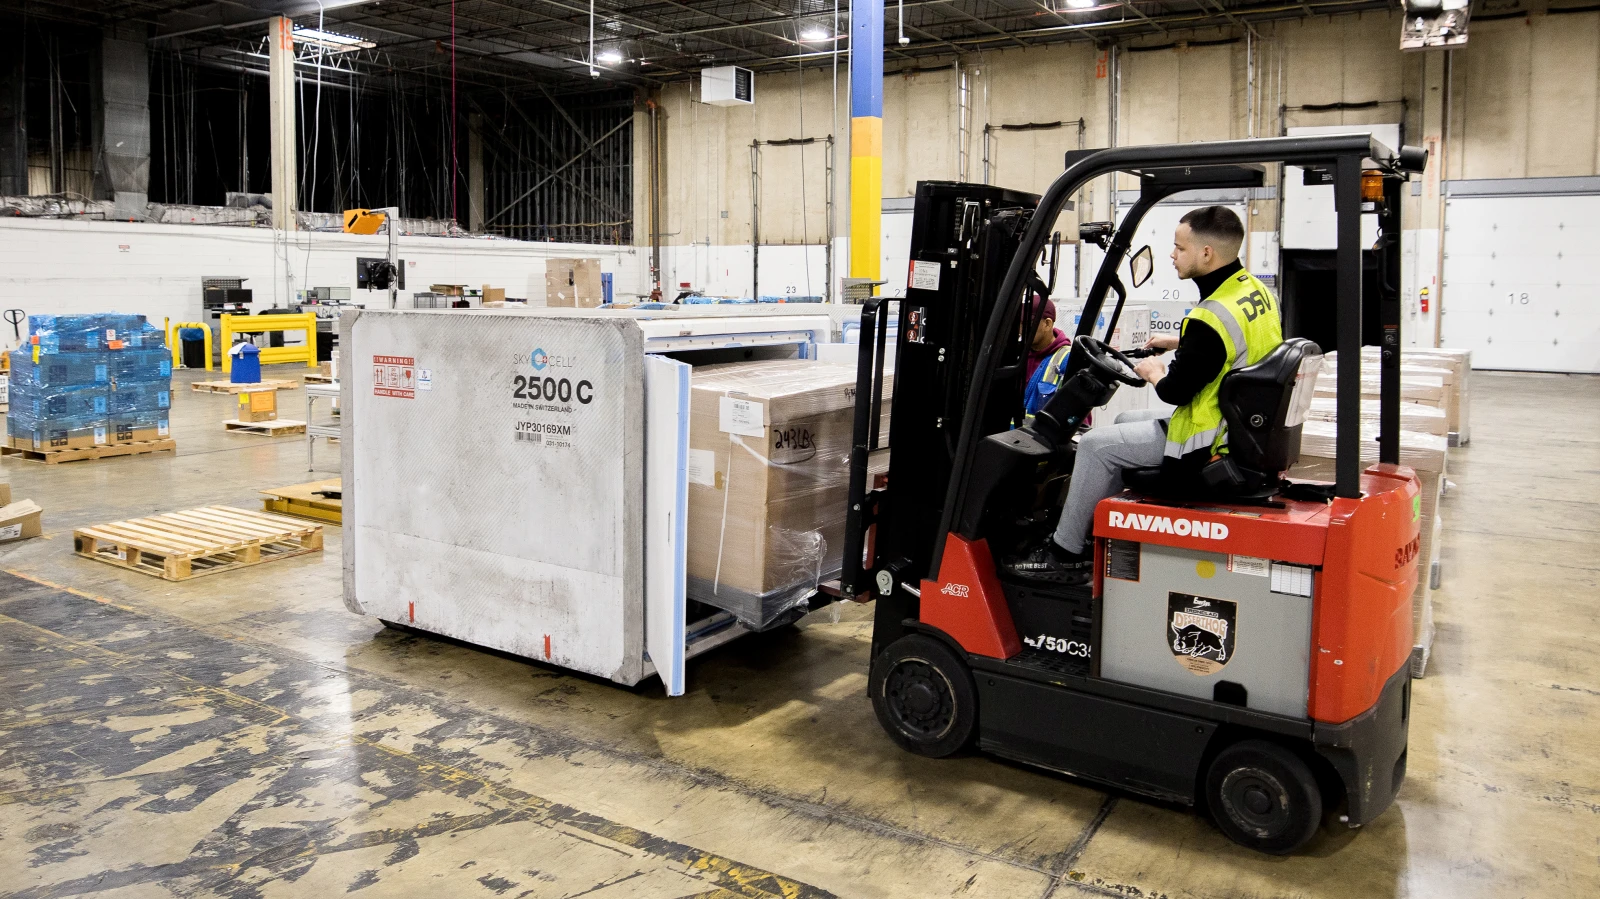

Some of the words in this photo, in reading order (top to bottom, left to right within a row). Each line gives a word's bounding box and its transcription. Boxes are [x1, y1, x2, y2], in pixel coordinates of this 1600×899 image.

[1162, 289, 1180, 300] 20
[1508, 292, 1530, 305] 18
[1236, 287, 1271, 323] DSV
[1150, 320, 1171, 330] 500
[374, 388, 391, 396] HANDLE
[513, 374, 572, 403] 2500
[576, 379, 593, 405] C
[513, 402, 527, 410] MADE
[535, 404, 573, 414] SWITZERLAND
[515, 421, 571, 436] JYP30169XM
[1108, 510, 1229, 540] RAYMOND
[941, 583, 970, 598] ACR
